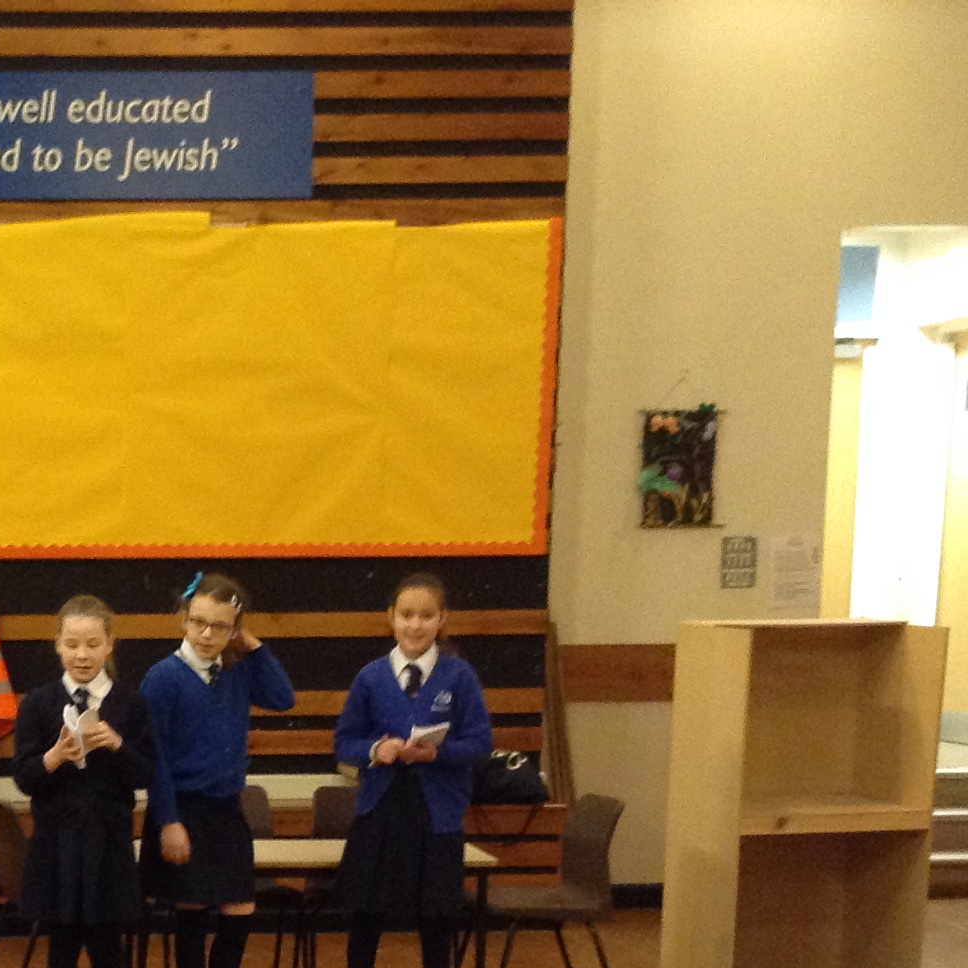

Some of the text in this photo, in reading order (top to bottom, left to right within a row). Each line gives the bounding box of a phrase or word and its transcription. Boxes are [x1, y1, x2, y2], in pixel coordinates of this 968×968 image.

[67, 91, 212, 125] educated
[32, 143, 62, 172] to
[75, 138, 110, 172] be
[117, 138, 239, 181] Jewish”
